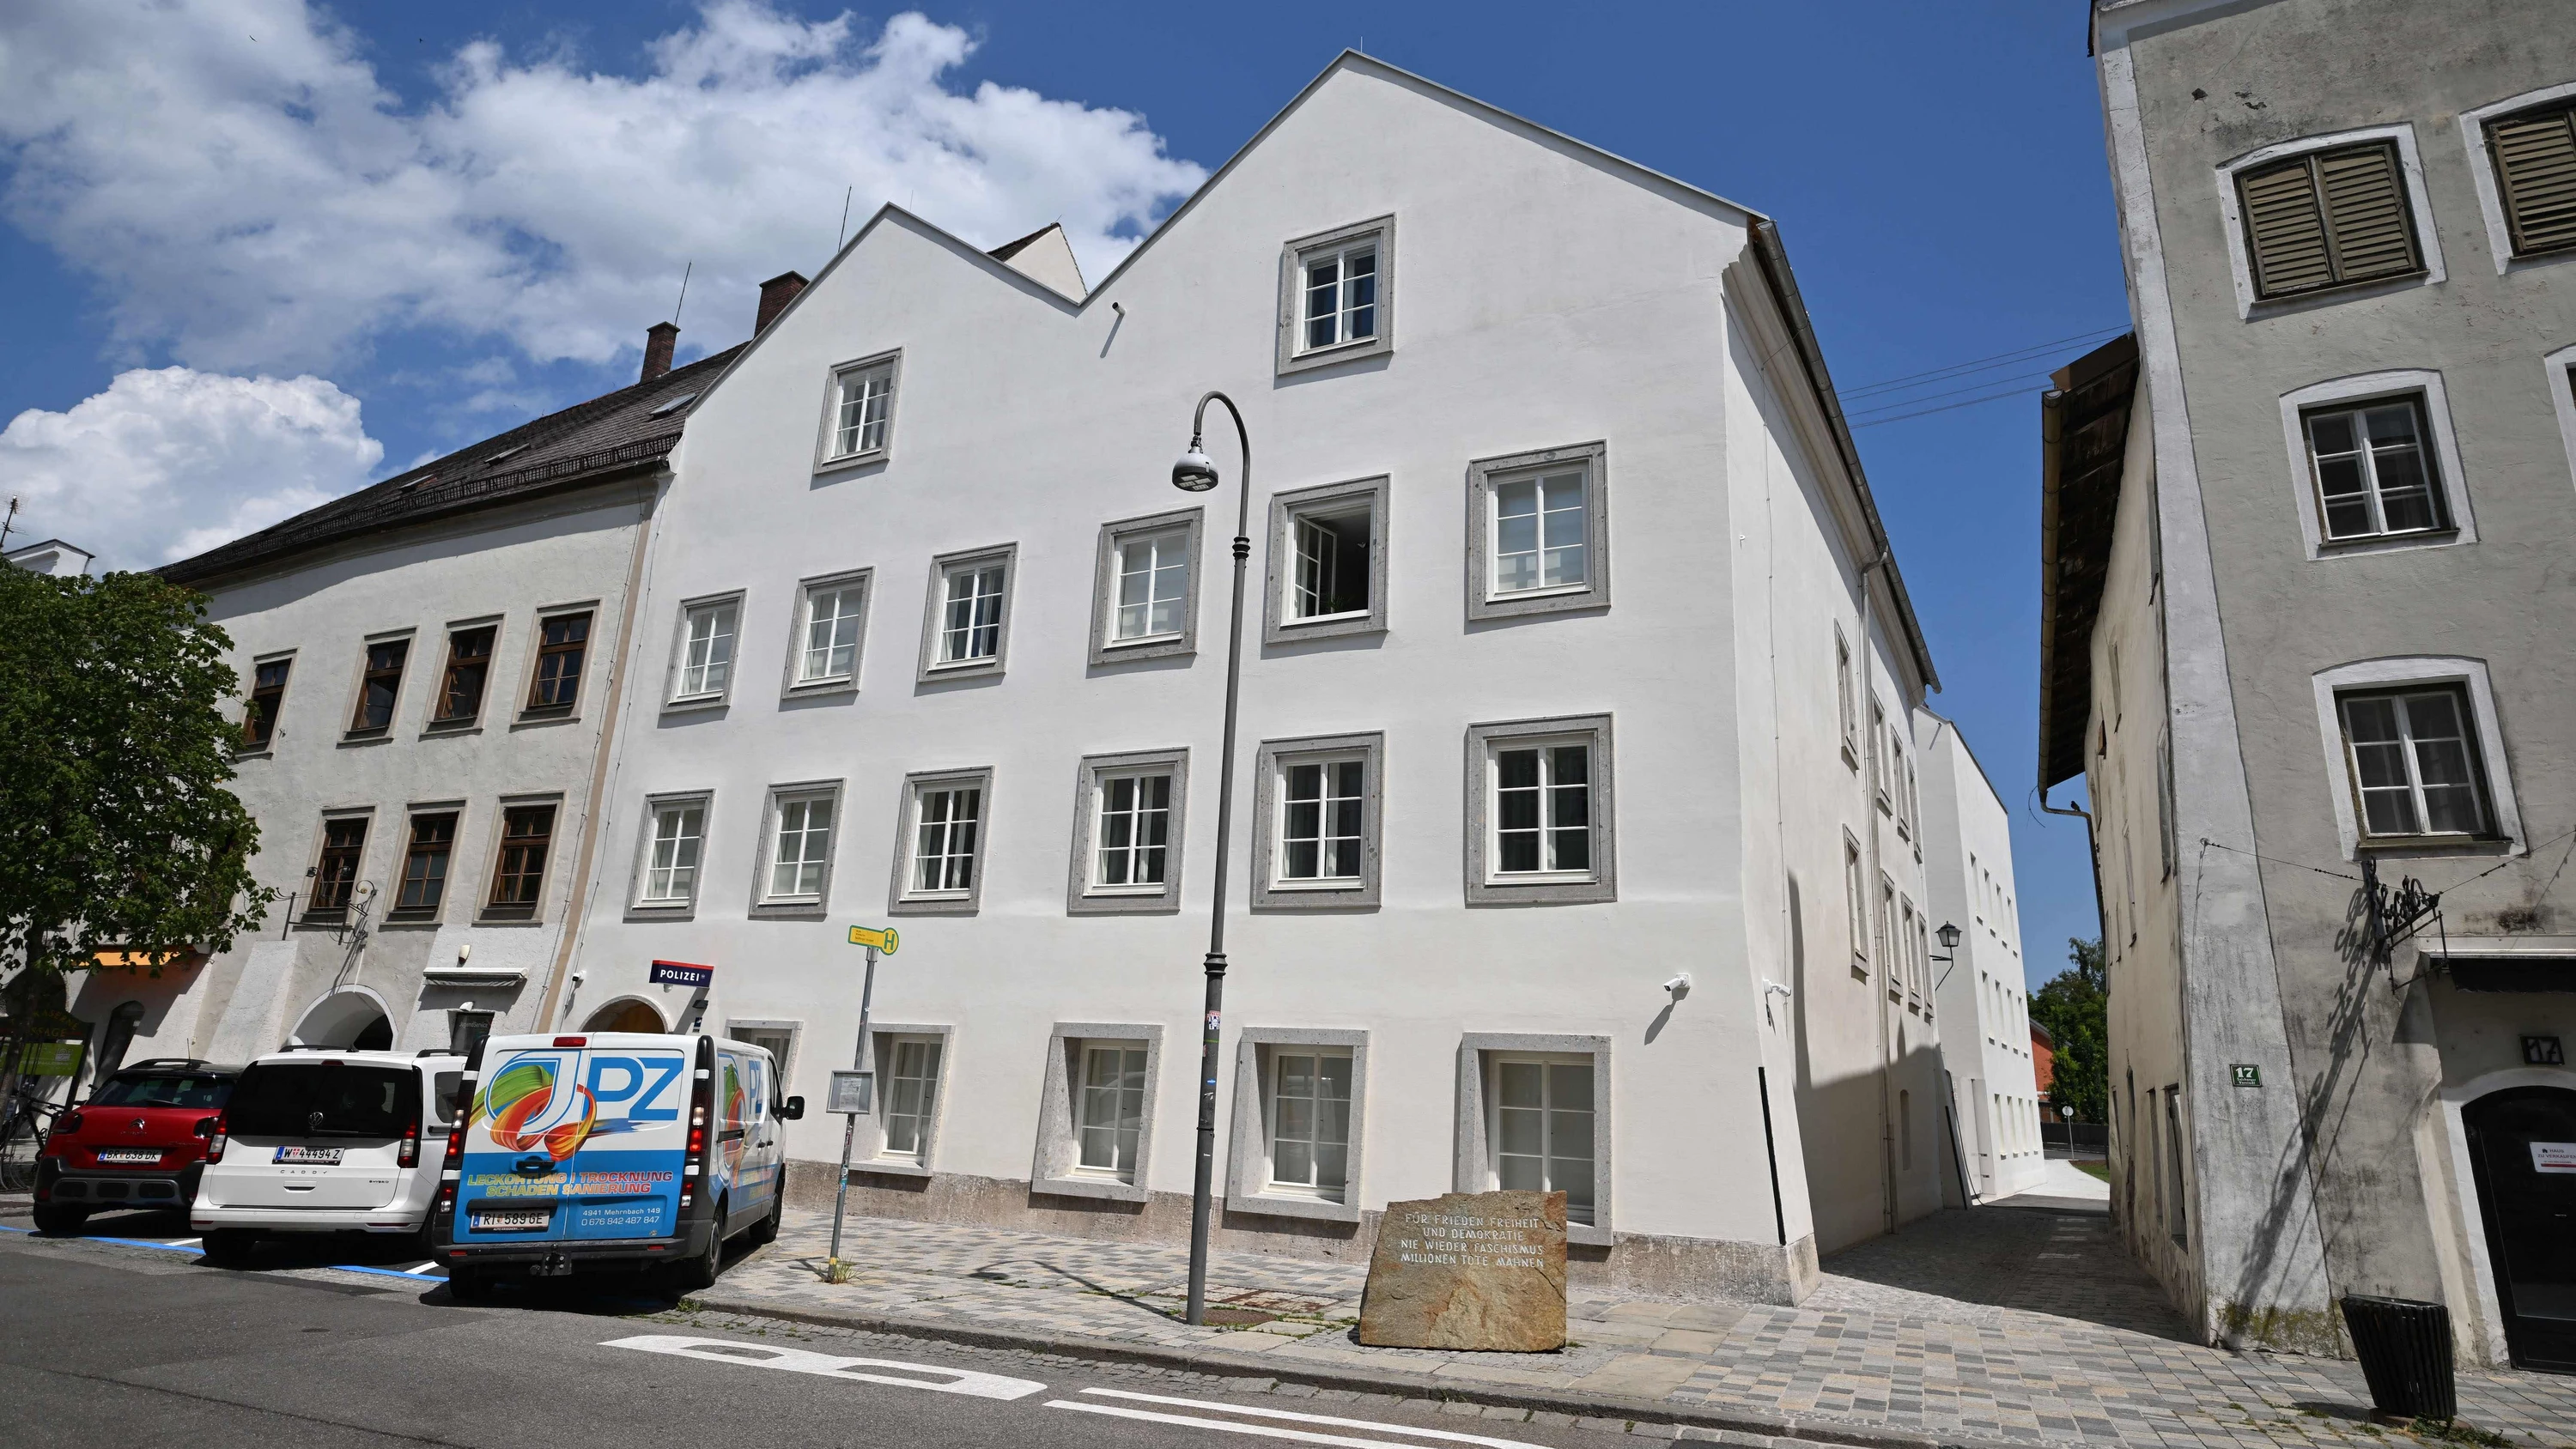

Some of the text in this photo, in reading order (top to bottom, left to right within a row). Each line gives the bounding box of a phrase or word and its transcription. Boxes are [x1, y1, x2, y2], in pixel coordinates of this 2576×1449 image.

[884, 932, 895, 950] H
[659, 969, 700, 982] POLIZEI
[2235, 1067, 2254, 1078] 17
[106, 1150, 118, 1159] BR
[125, 1150, 143, 1159] 638
[144, 1150, 158, 1160] DK
[284, 1149, 293, 1157] W
[300, 1149, 331, 1159] 44494
[332, 1149, 340, 1159] Z
[467, 1173, 567, 1185] LECKORTUNG
[580, 1171, 673, 1184] TROCKNUNG
[486, 1183, 652, 1197] SCHADEN SANIERUNG
[483, 1213, 495, 1225] RI
[504, 1213, 527, 1225] 589
[529, 1212, 544, 1224] GE
[625, 1216, 641, 1225] 487
[643, 1216, 659, 1224] 847
[1406, 1212, 1539, 1228] FÜR FRIEDEN FREIHEIT
[1423, 1227, 1524, 1241] UND DEMOKRATIE
[1400, 1240, 1545, 1255] NIE WIEDER FASCHISMUS
[1400, 1253, 1545, 1268] MILLIONEN TOTE MAHNEN
